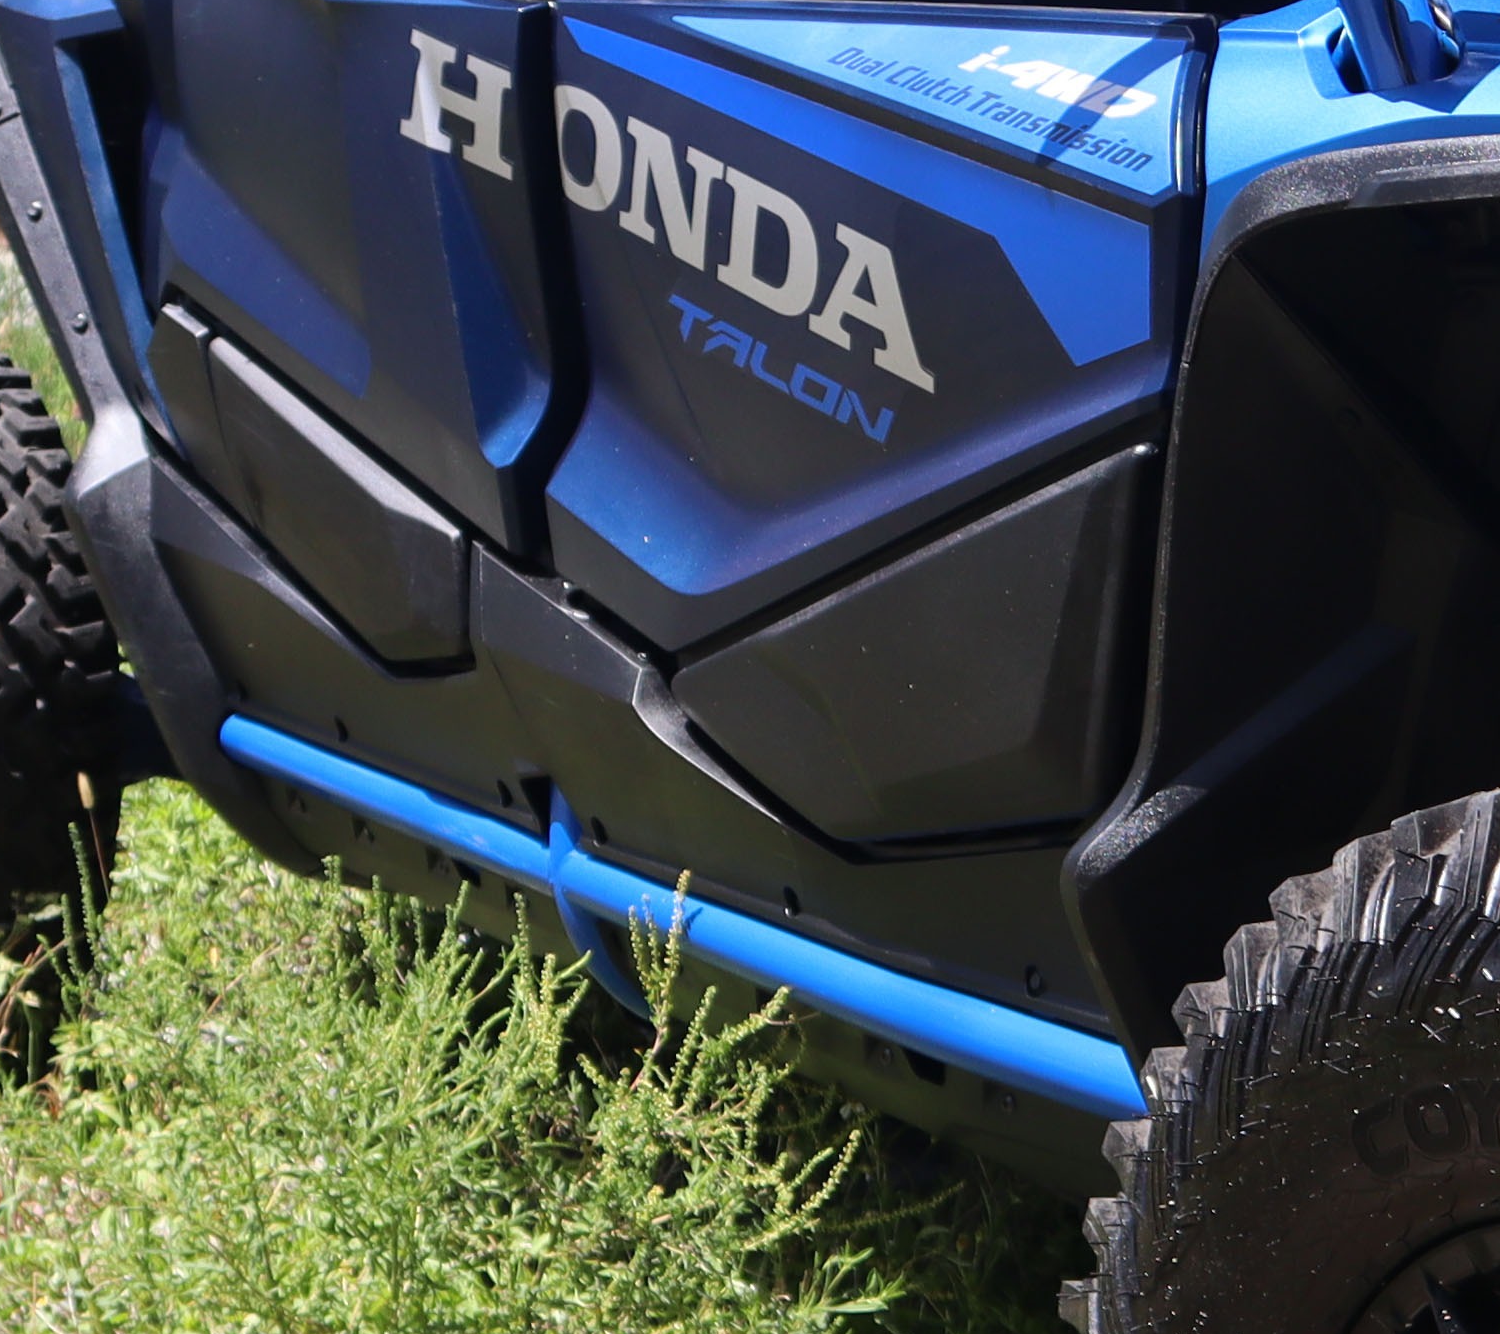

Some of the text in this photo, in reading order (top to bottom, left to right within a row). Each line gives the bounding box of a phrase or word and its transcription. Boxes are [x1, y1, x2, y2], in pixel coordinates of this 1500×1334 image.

[827, 47, 1153, 171] Dual Clutch Transmission
[957, 45, 1156, 118] i-4WD
[400, 29, 934, 394] HONDA
[669, 294, 894, 442] TALON
